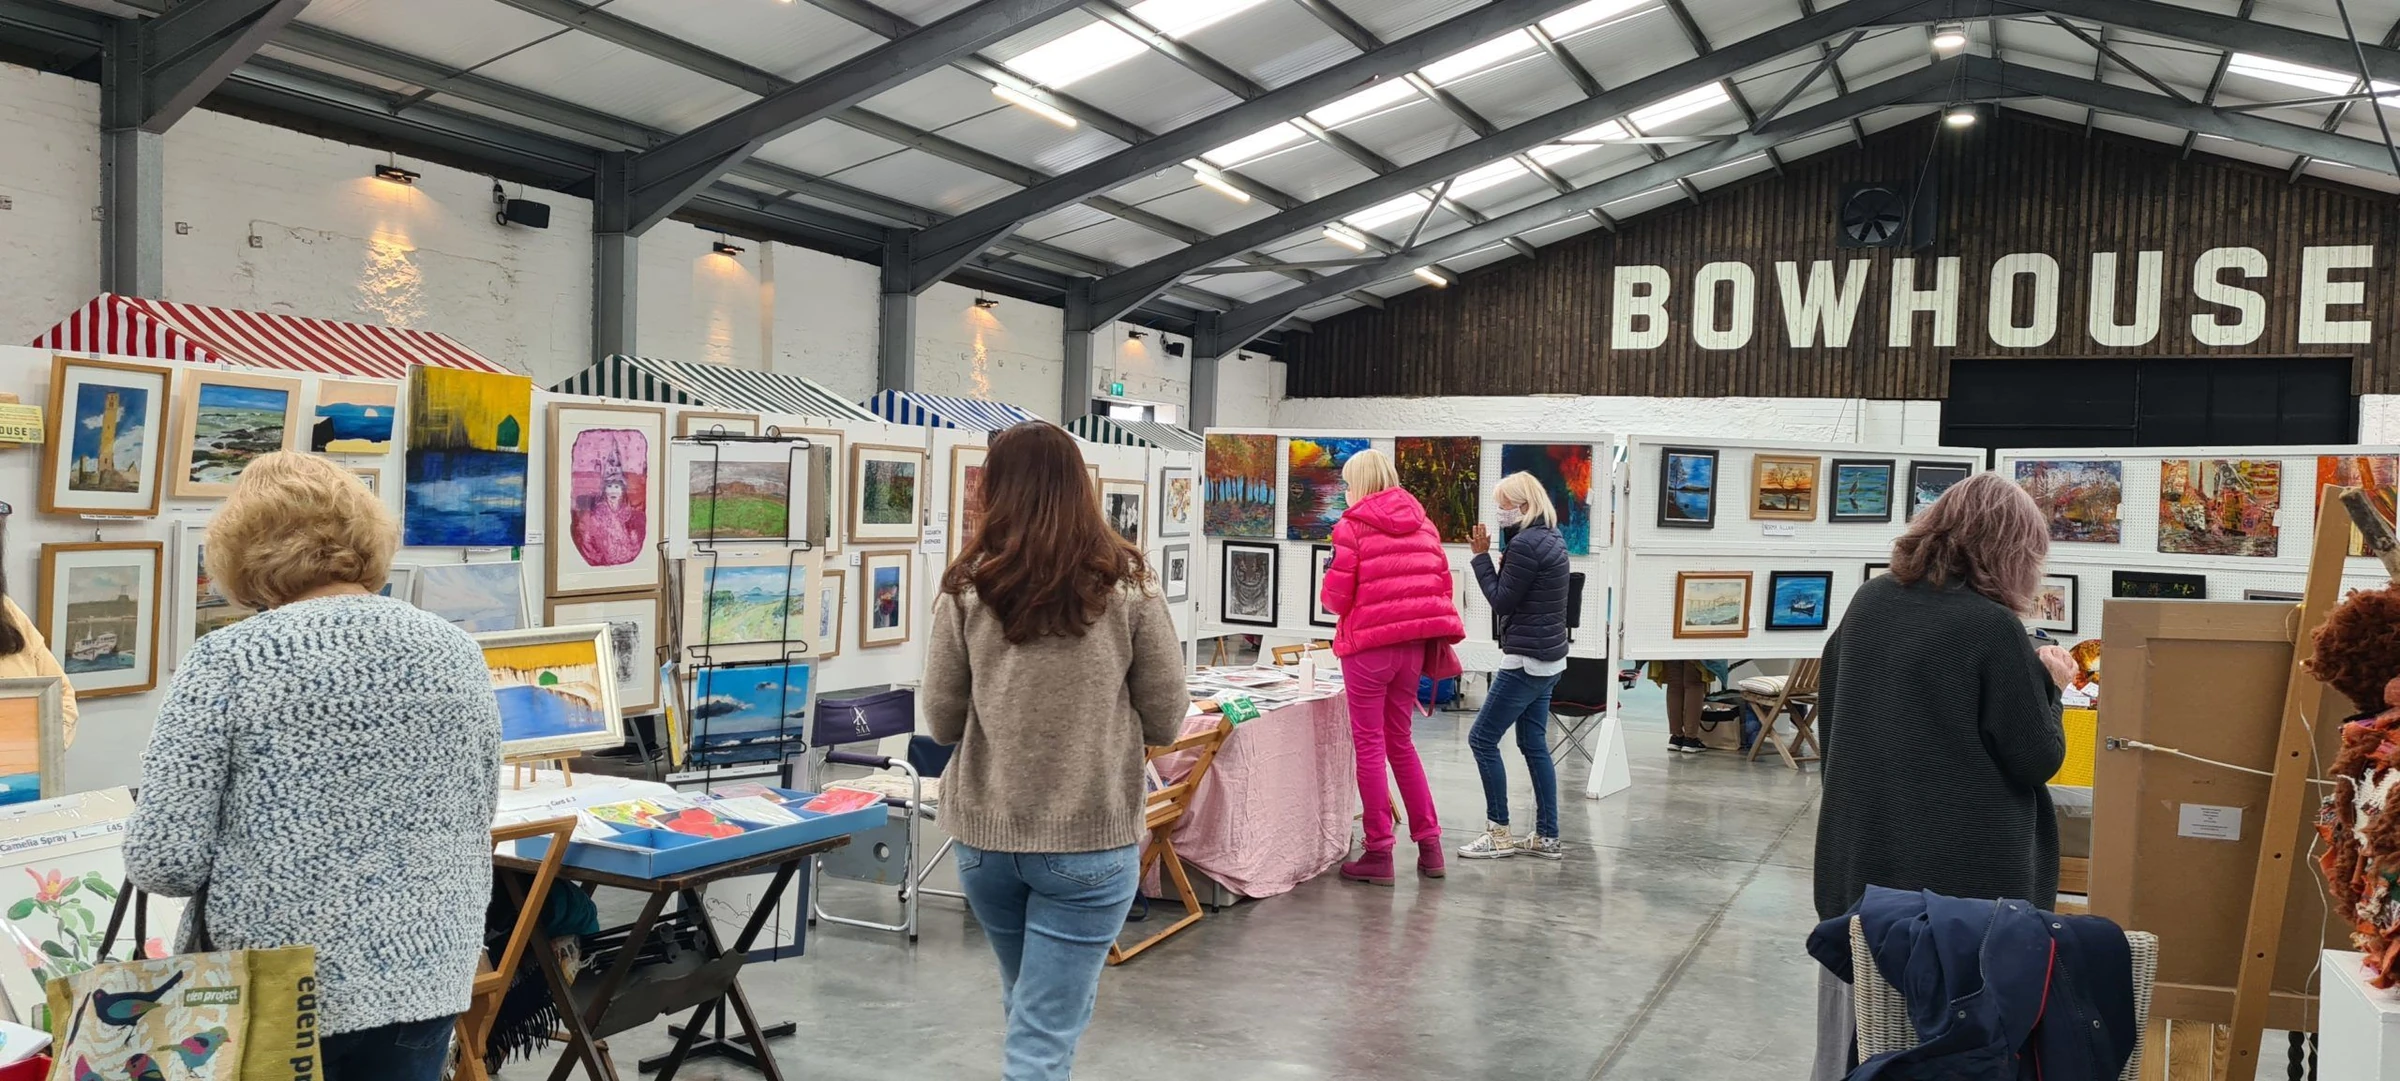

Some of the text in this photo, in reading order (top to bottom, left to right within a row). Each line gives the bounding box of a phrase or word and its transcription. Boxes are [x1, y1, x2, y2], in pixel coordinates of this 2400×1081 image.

[1611, 245, 2374, 351] BOWHOUSE
[40, 834, 67, 846] Spray
[106, 822, 124, 833] £45
[186, 988, 239, 1002] eden project
